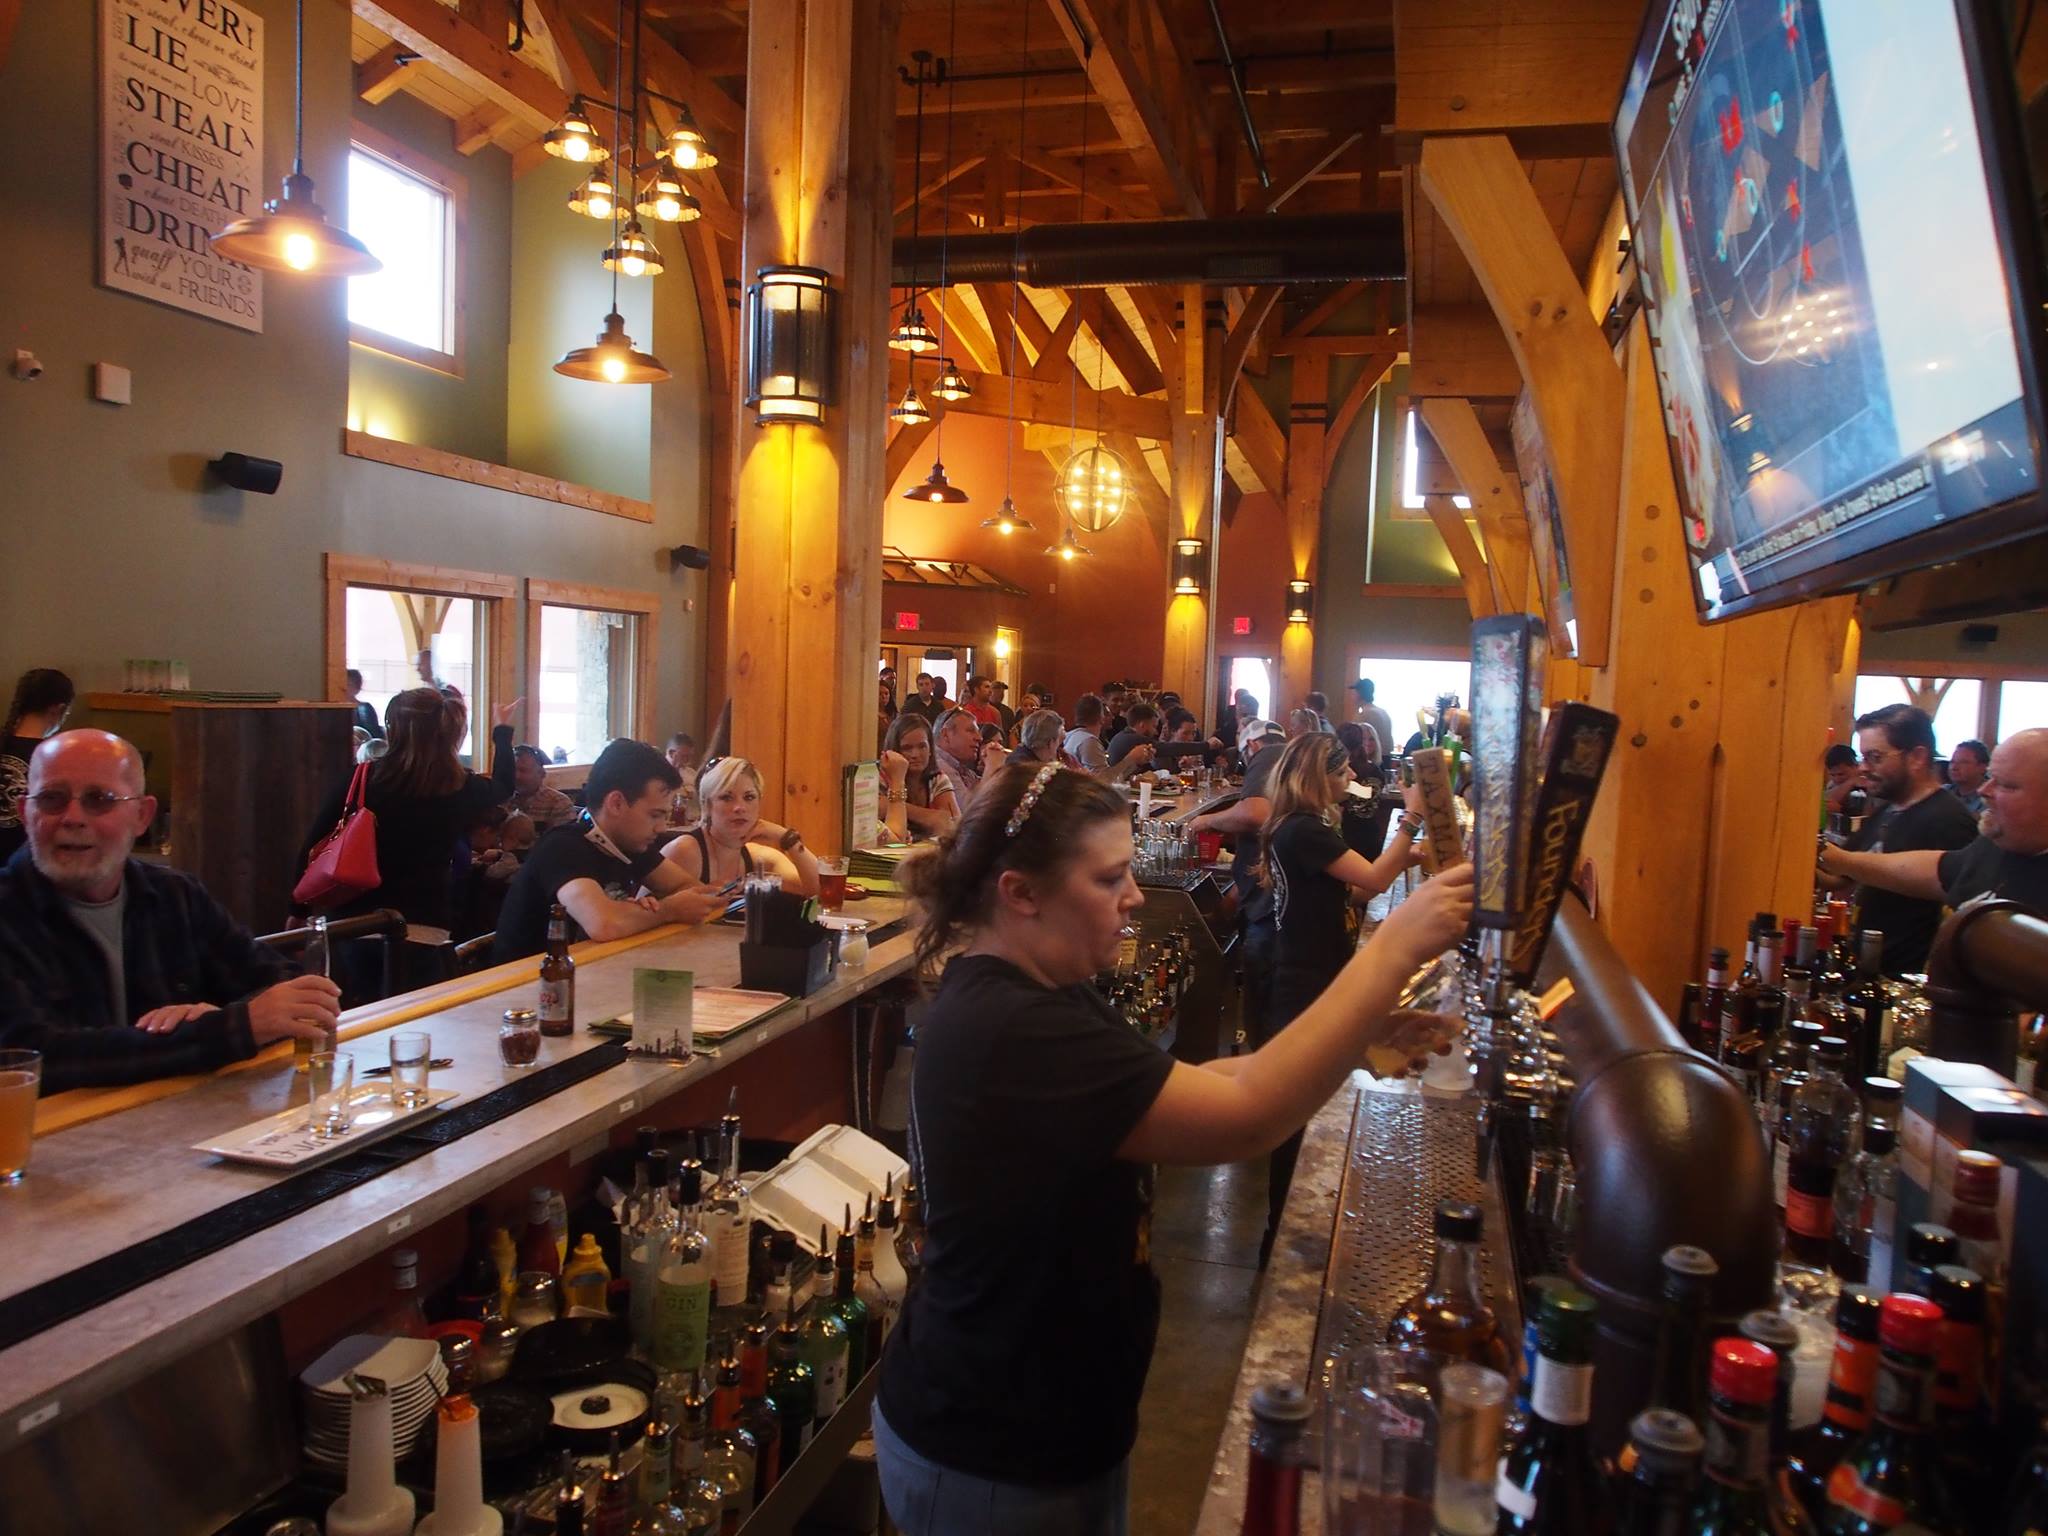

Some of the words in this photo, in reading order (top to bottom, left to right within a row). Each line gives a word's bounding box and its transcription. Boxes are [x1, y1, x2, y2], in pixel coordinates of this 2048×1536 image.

[126, 13, 189, 73] LIE
[127, 77, 243, 158] STEAL
[192, 75, 253, 124] LOVE
[180, 137, 225, 170] KISSES
[127, 141, 250, 216] CHEAT
[131, 245, 176, 272] quaff
[180, 253, 235, 290] YOUR
[179, 277, 257, 318] FRIENDS
[1419, 755, 1454, 868] TAXMA
[664, 1296, 697, 1311] GIN
